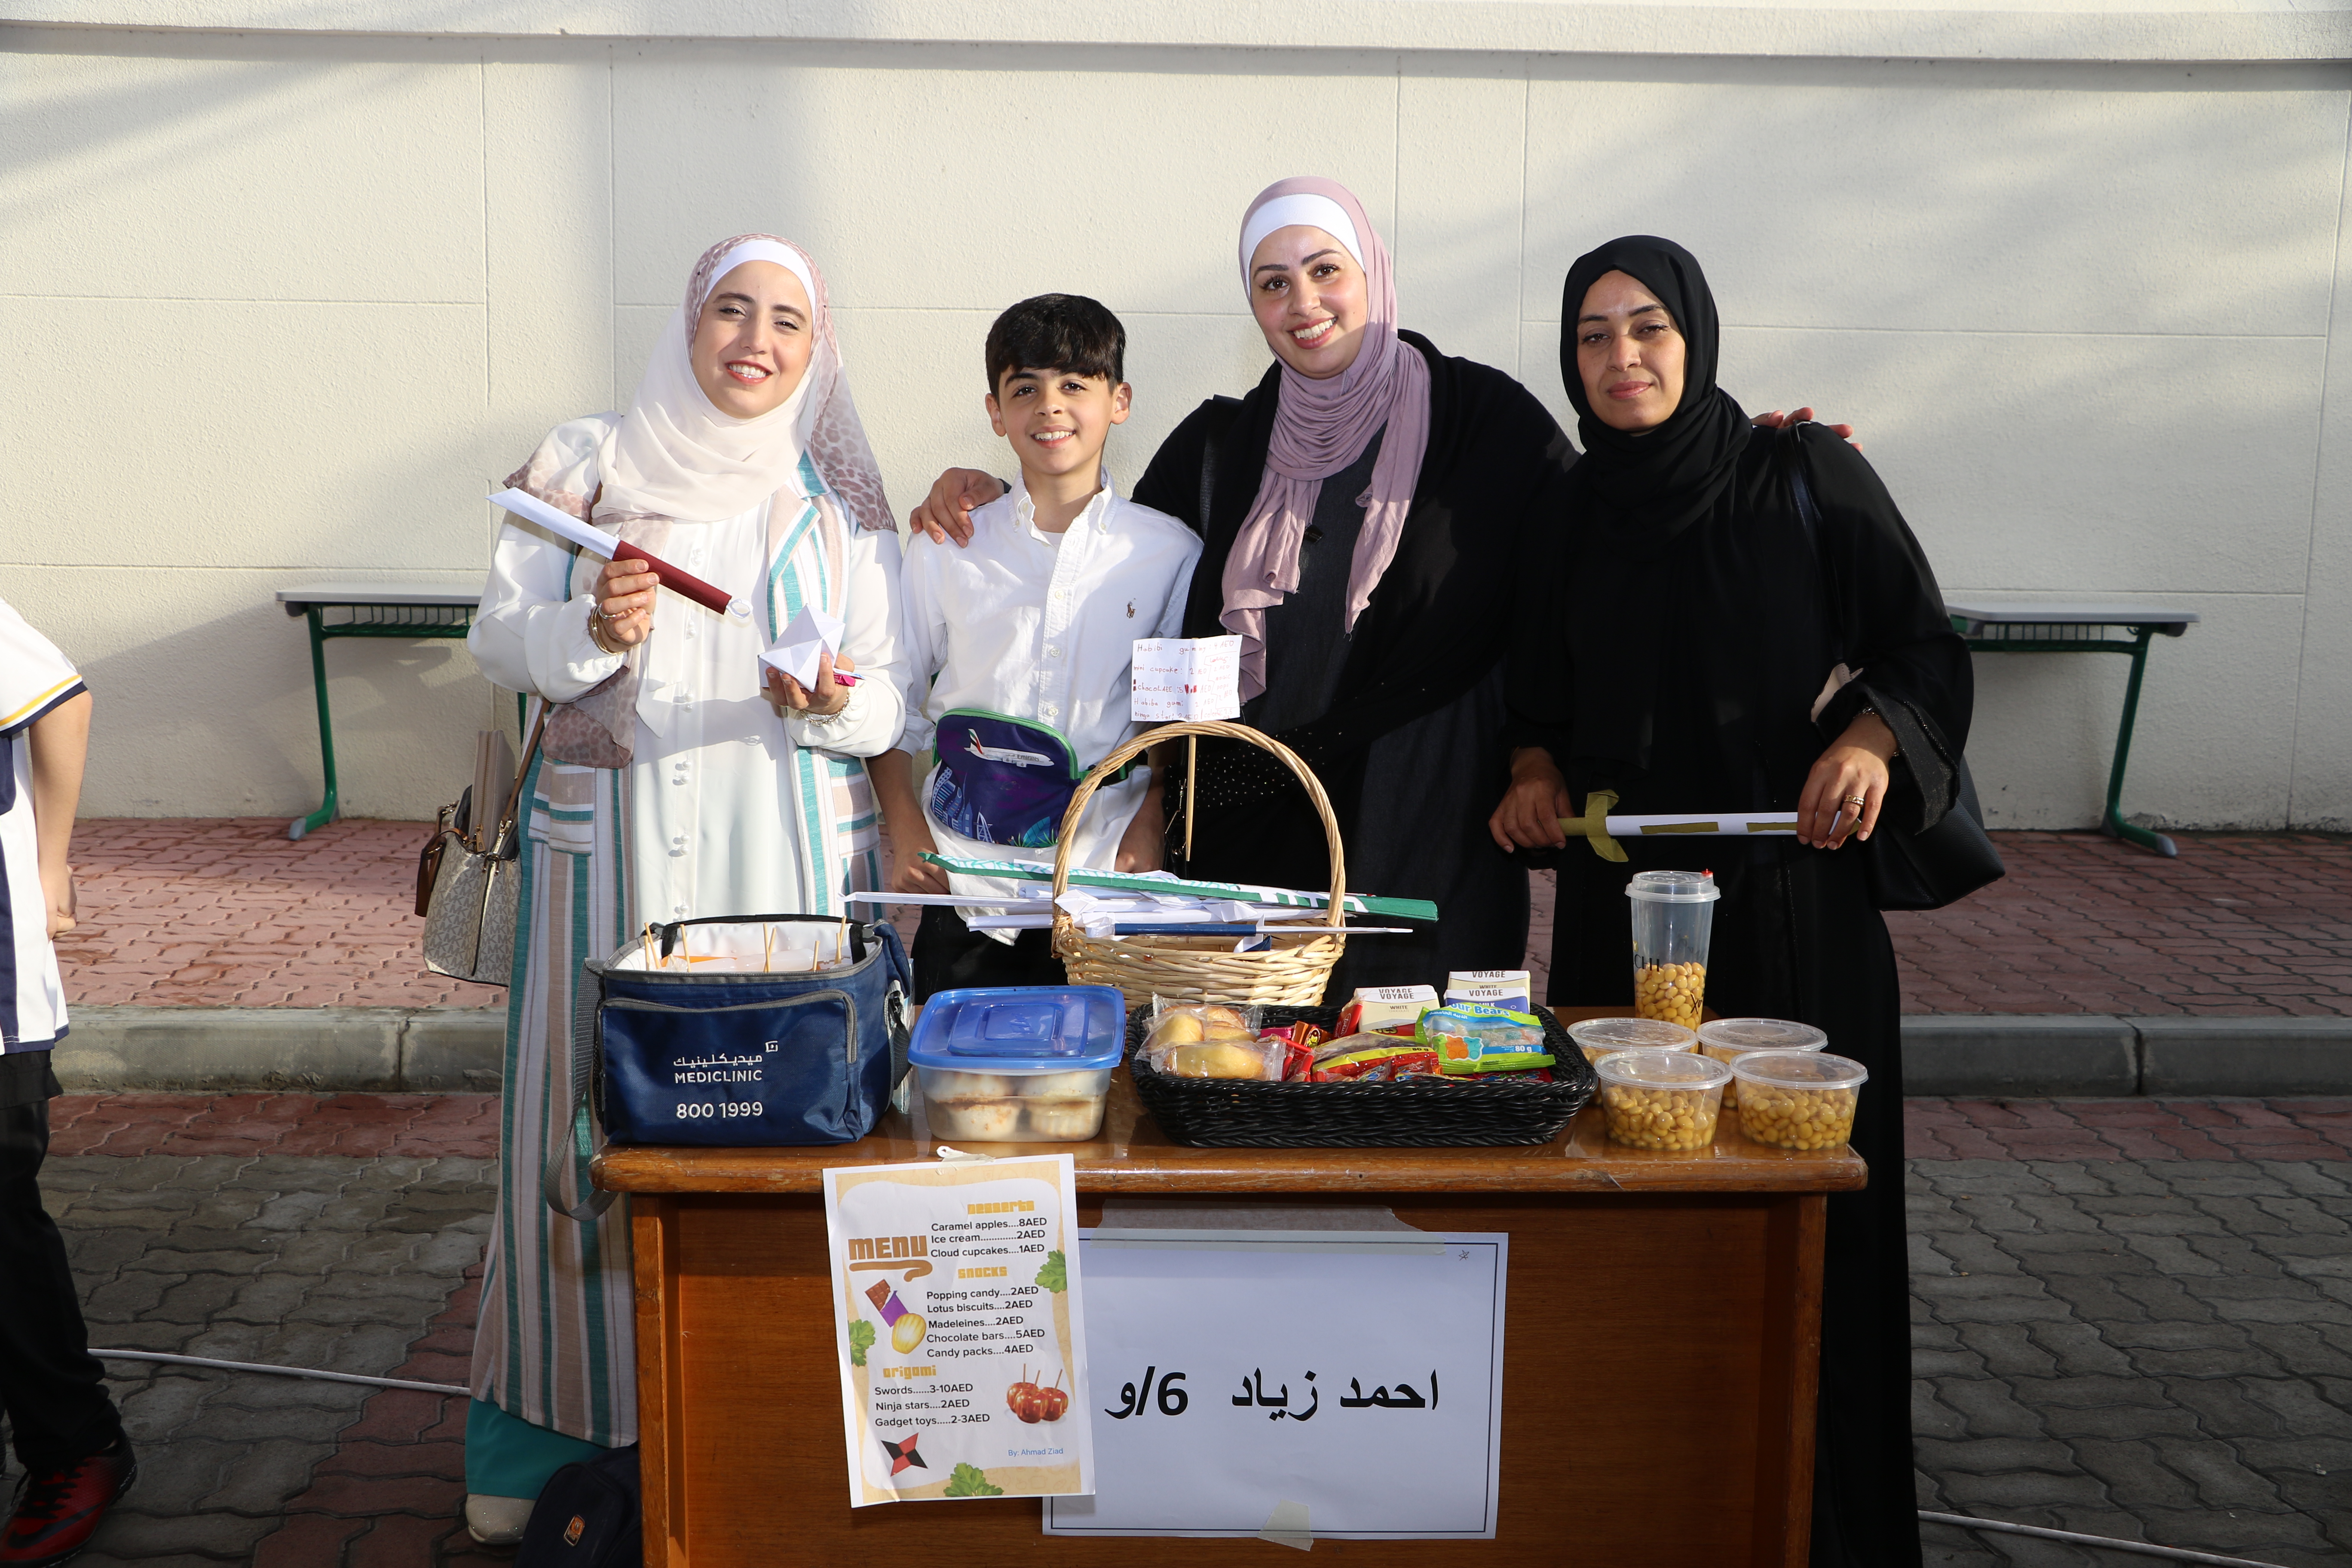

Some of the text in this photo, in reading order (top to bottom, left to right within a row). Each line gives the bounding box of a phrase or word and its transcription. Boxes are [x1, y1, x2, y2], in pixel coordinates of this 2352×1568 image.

[1137, 642, 1162, 652] Habibi
[1474, 1005, 1510, 1017] Bears
[674, 1053, 763, 1069] ميديكلينيك
[674, 1069, 763, 1084] MEDICLINIC
[676, 1101, 763, 1119] 800 1999
[931, 1222, 972, 1231] Caramel
[931, 1234, 946, 1243] Ice
[931, 1249, 959, 1258] Cloud
[927, 1291, 967, 1302] Popping
[927, 1305, 954, 1313] Lotus
[927, 1333, 979, 1343] Chocolate
[927, 1348, 960, 1358] Candy
[883, 1364, 937, 1380] origami
[1231, 1367, 1318, 1422] زياد
[1340, 1368, 1439, 1412] احمد
[876, 1402, 902, 1412] Ninja
[875, 1418, 913, 1428] Gadget
